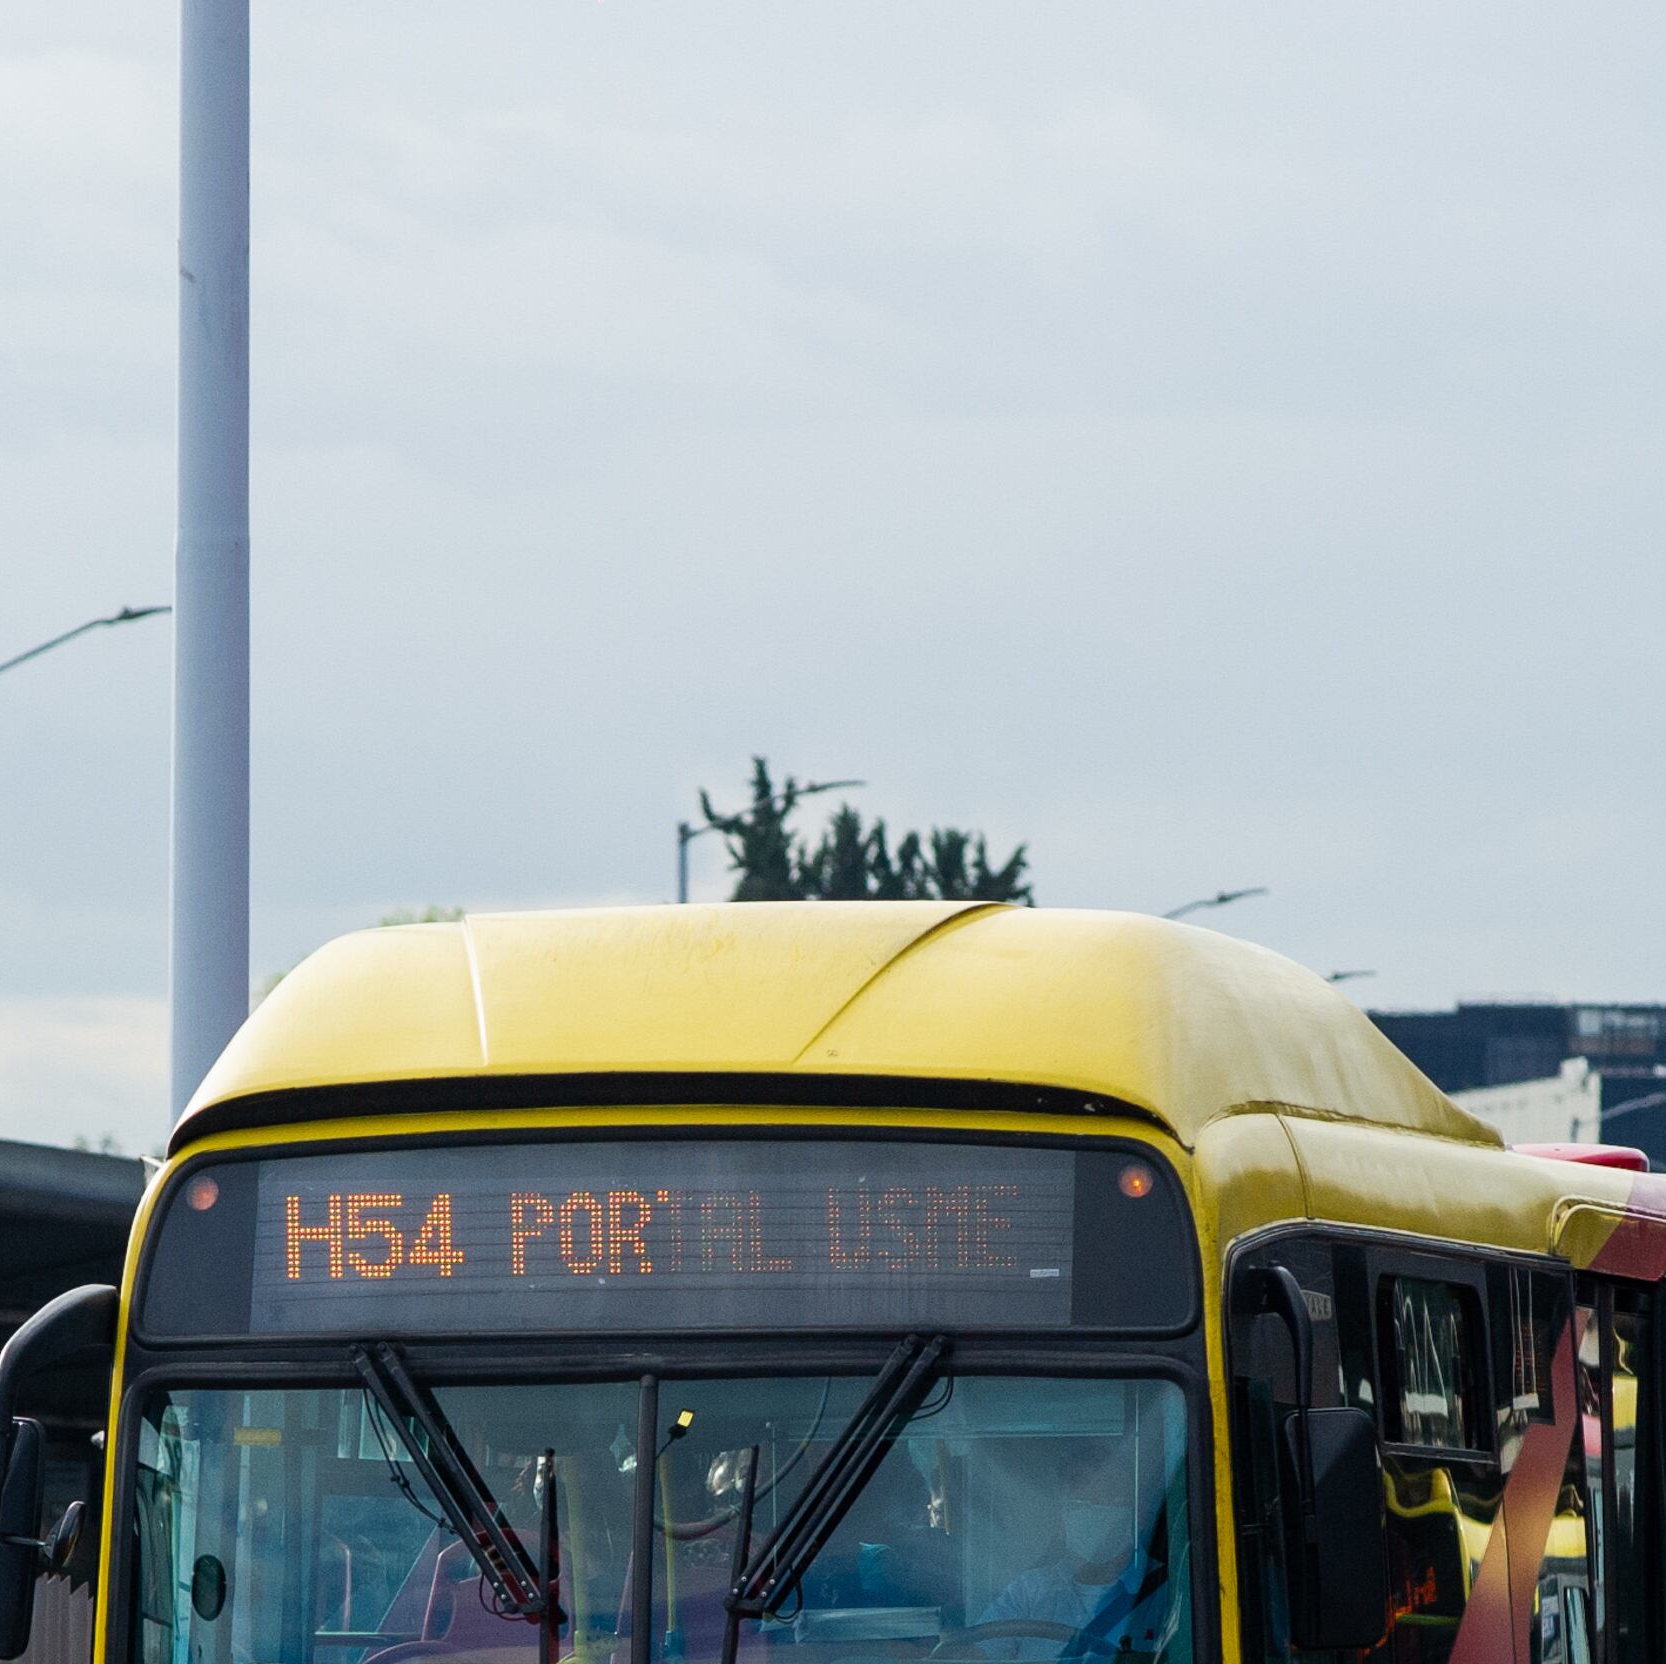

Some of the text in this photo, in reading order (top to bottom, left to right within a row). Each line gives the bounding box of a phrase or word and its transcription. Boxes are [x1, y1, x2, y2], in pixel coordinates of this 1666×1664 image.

[286, 1184, 1019, 1279] H54 PORTAL USME
